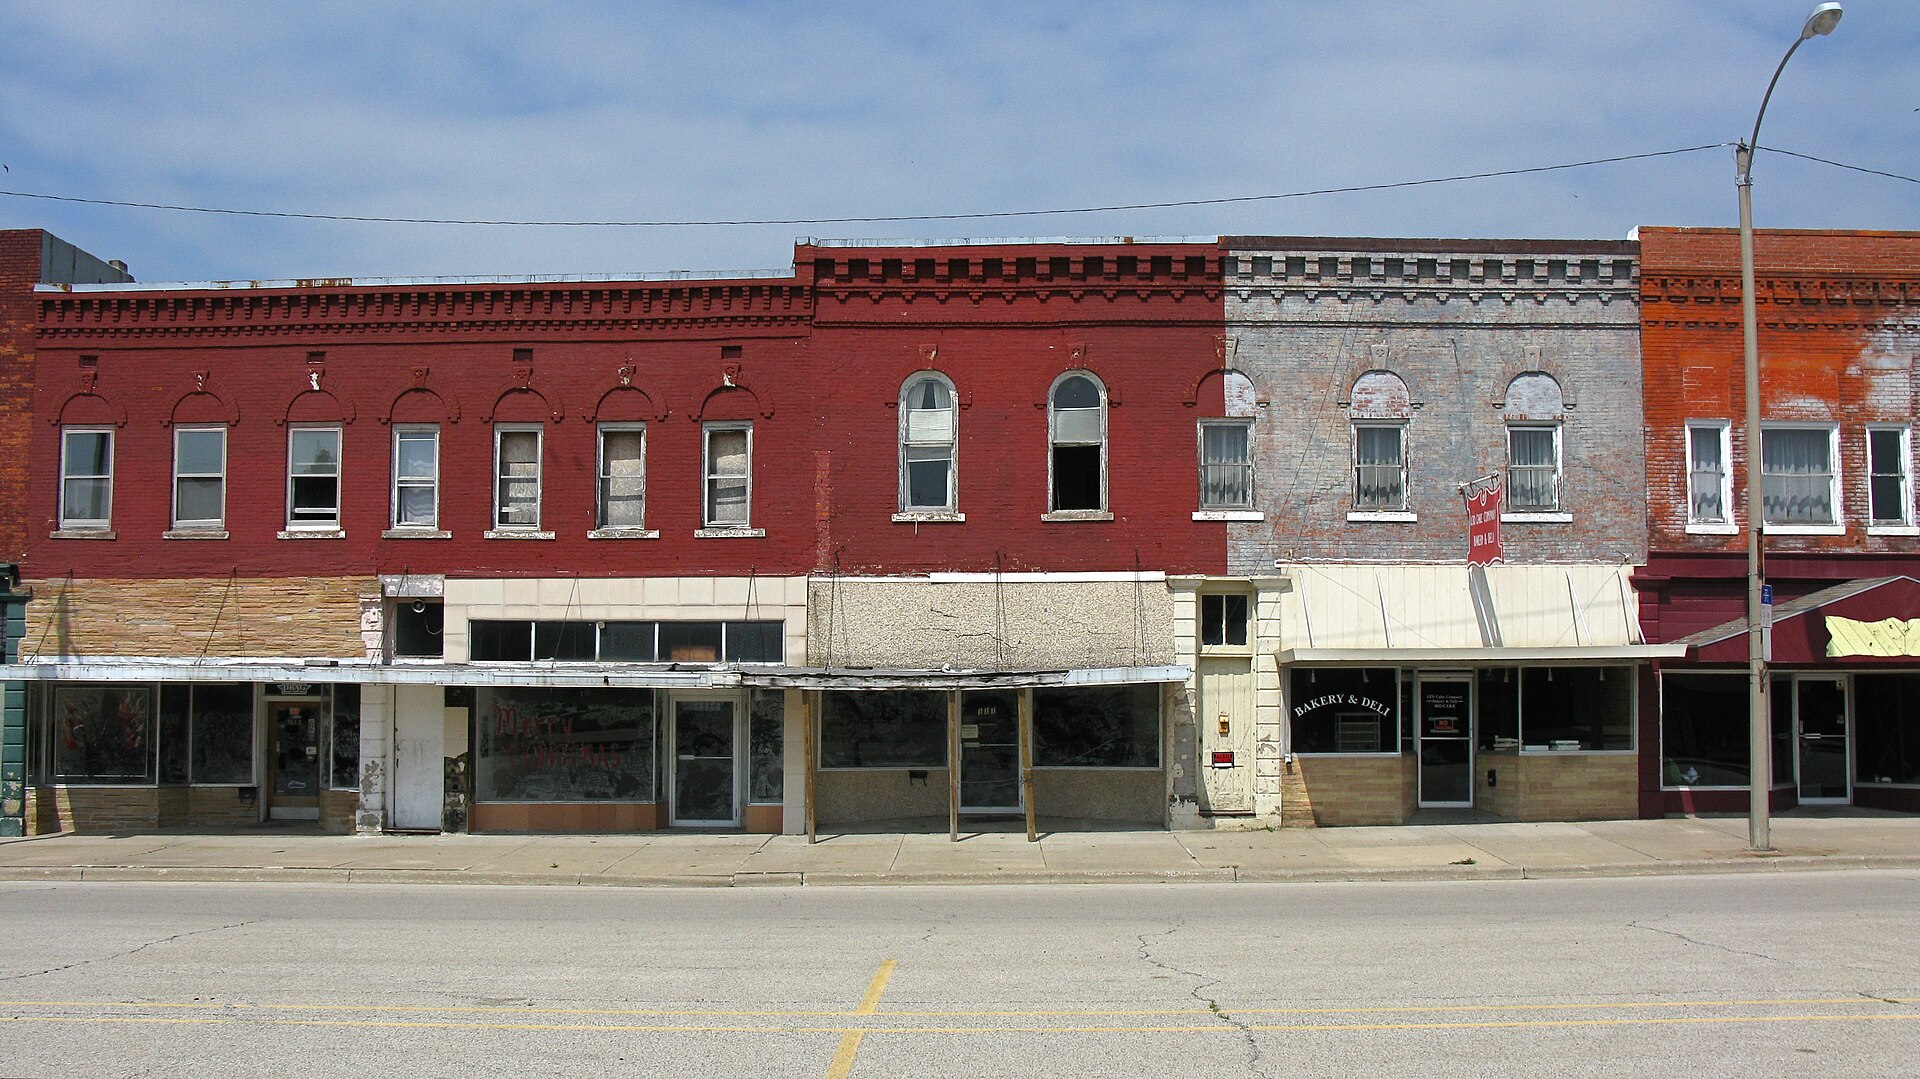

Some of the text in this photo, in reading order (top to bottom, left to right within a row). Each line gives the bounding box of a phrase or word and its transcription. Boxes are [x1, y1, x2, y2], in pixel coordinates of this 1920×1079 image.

[1294, 694, 1391, 717] BAKERY & DELI
